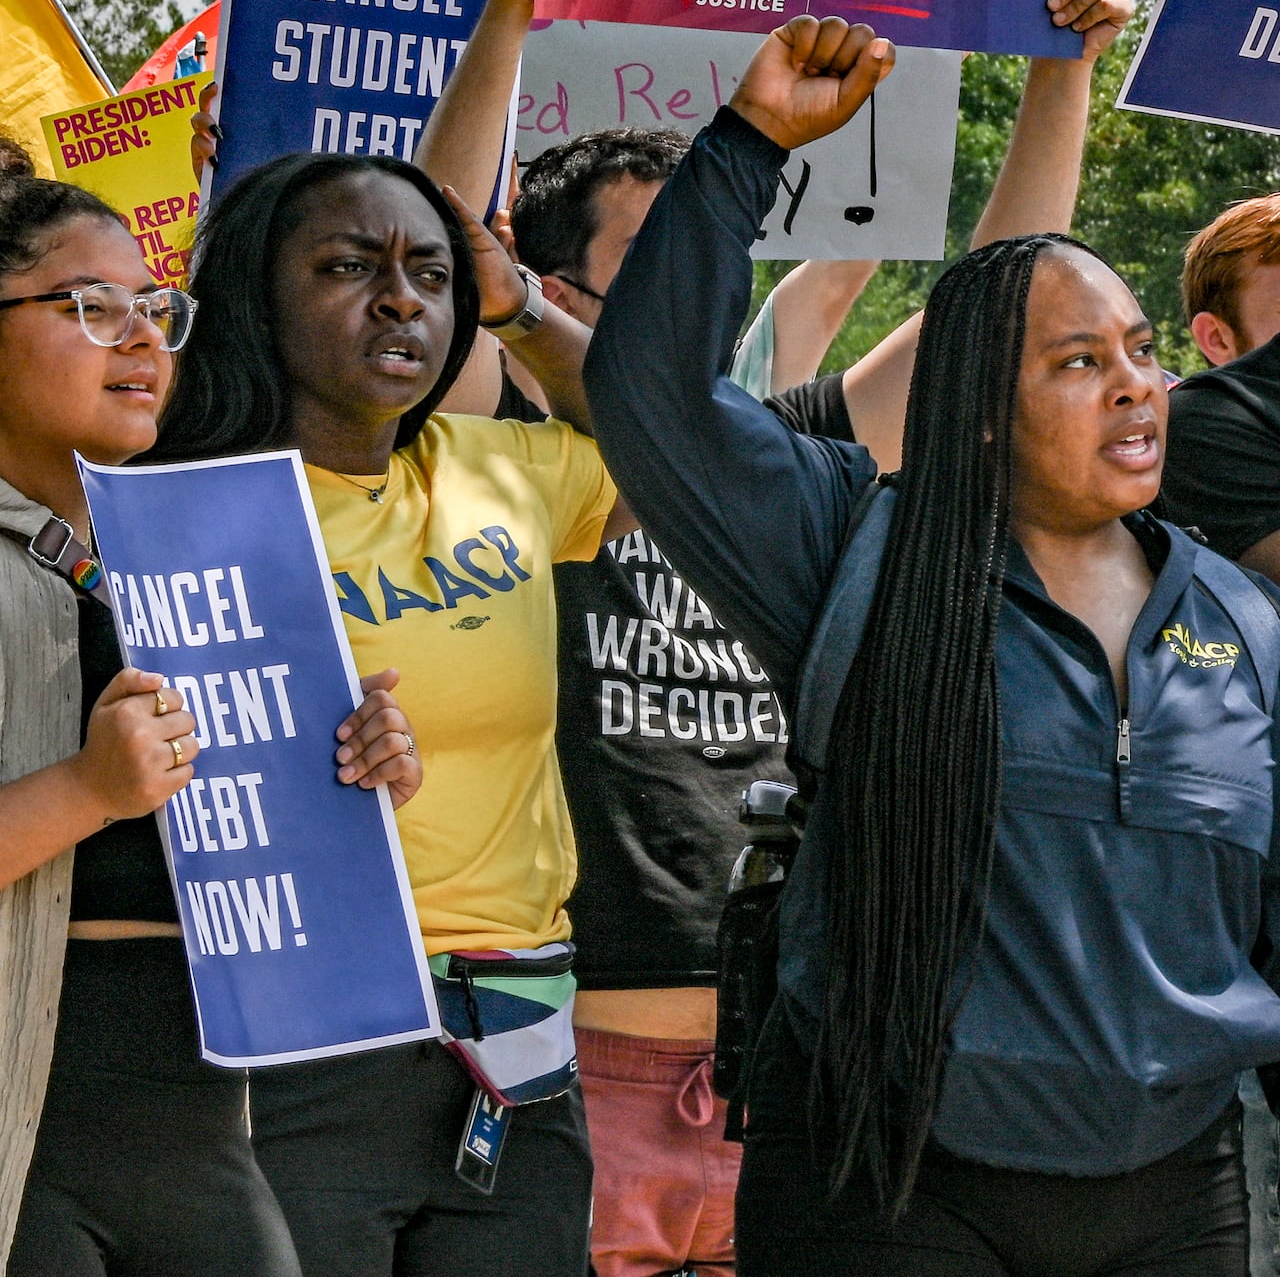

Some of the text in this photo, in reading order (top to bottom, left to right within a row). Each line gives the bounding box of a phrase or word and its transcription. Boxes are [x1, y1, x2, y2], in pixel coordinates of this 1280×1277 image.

[53, 81, 197, 143] PRESIDENT
[61, 125, 152, 169] BIDEN:
[110, 565, 265, 648] CANCEL
[1161, 623, 1240, 660] NAACP
[172, 772, 270, 853] DEBT
[185, 873, 308, 956] NOW!
